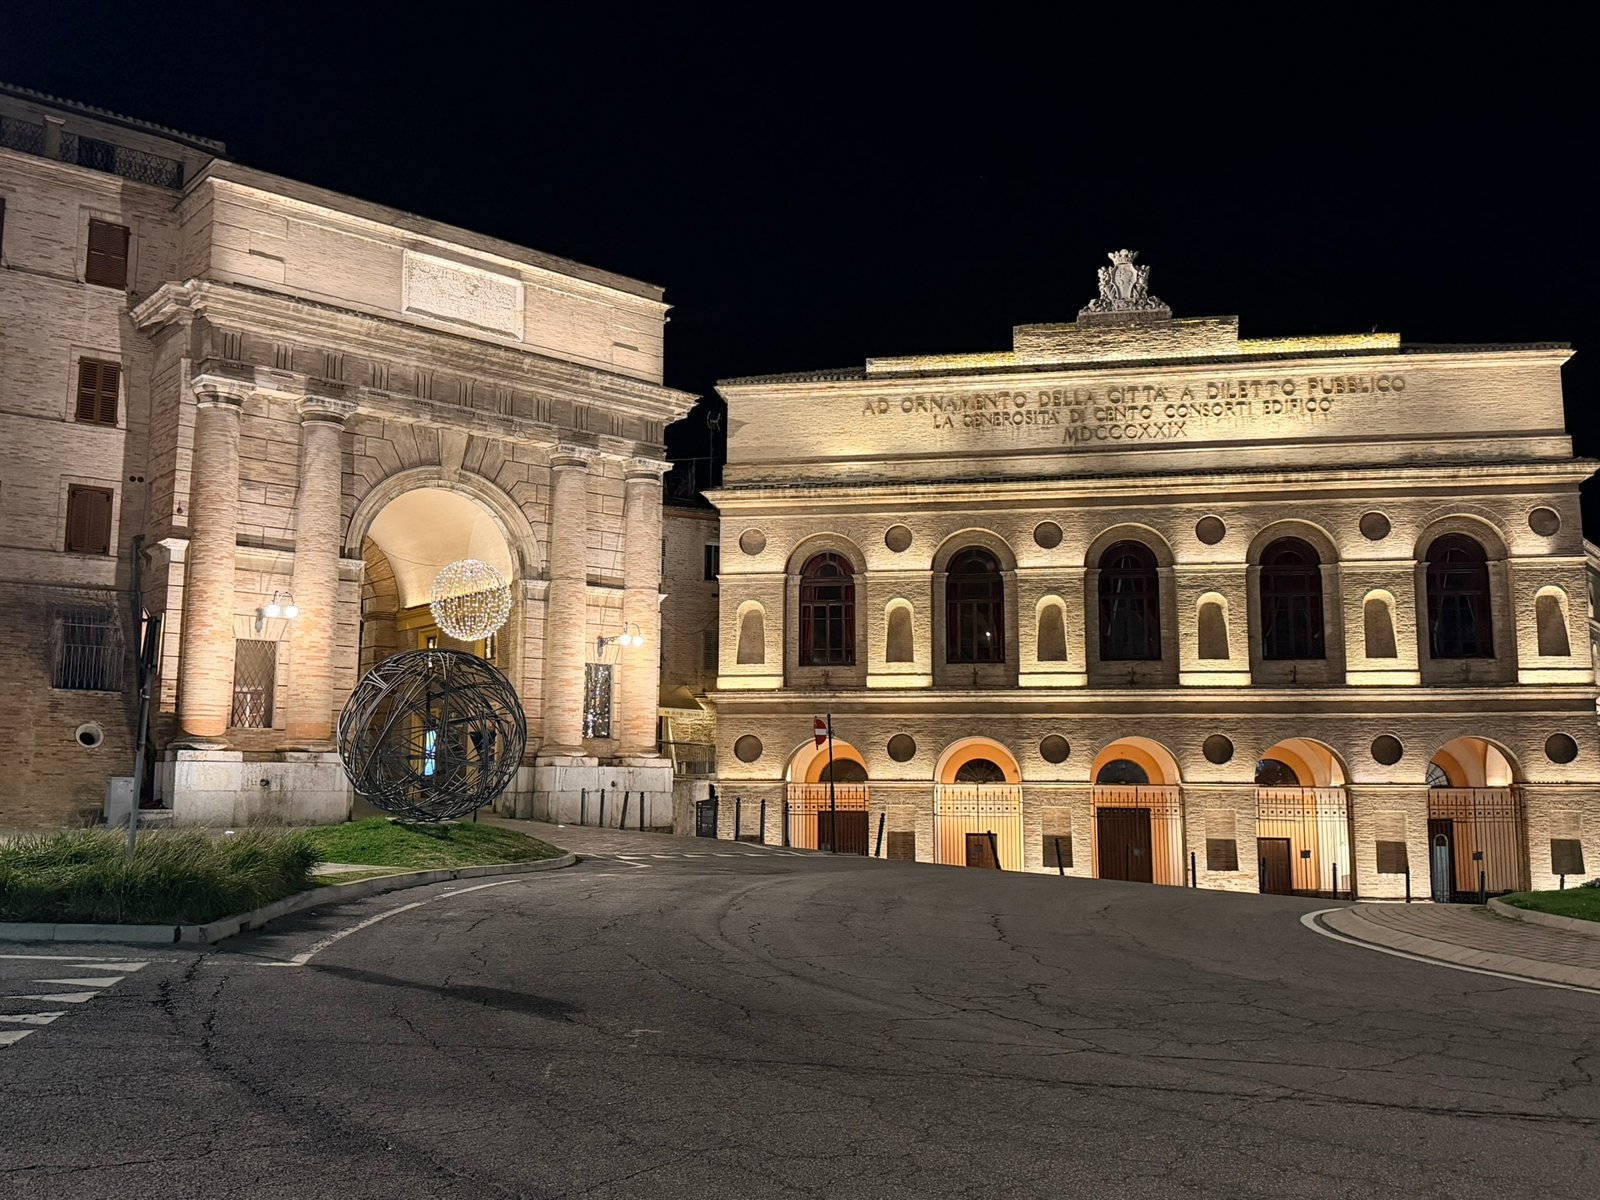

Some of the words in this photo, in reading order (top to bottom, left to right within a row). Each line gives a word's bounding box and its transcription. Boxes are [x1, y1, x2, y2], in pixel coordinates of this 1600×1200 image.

[862, 397, 890, 416] AD
[900, 389, 1028, 414] ORNAMENTO
[1038, 388, 1097, 408] DELLA
[1180, 386, 1194, 401] A
[1206, 378, 1296, 400] DILETTO
[1307, 374, 1406, 395] PUBBLICO
[933, 413, 954, 429] LA
[1069, 408, 1085, 424] DI
[1095, 404, 1152, 422] CENTO
[1164, 401, 1252, 418] CONSORTI
[1062, 421, 1188, 445] MDCCCXXIX
